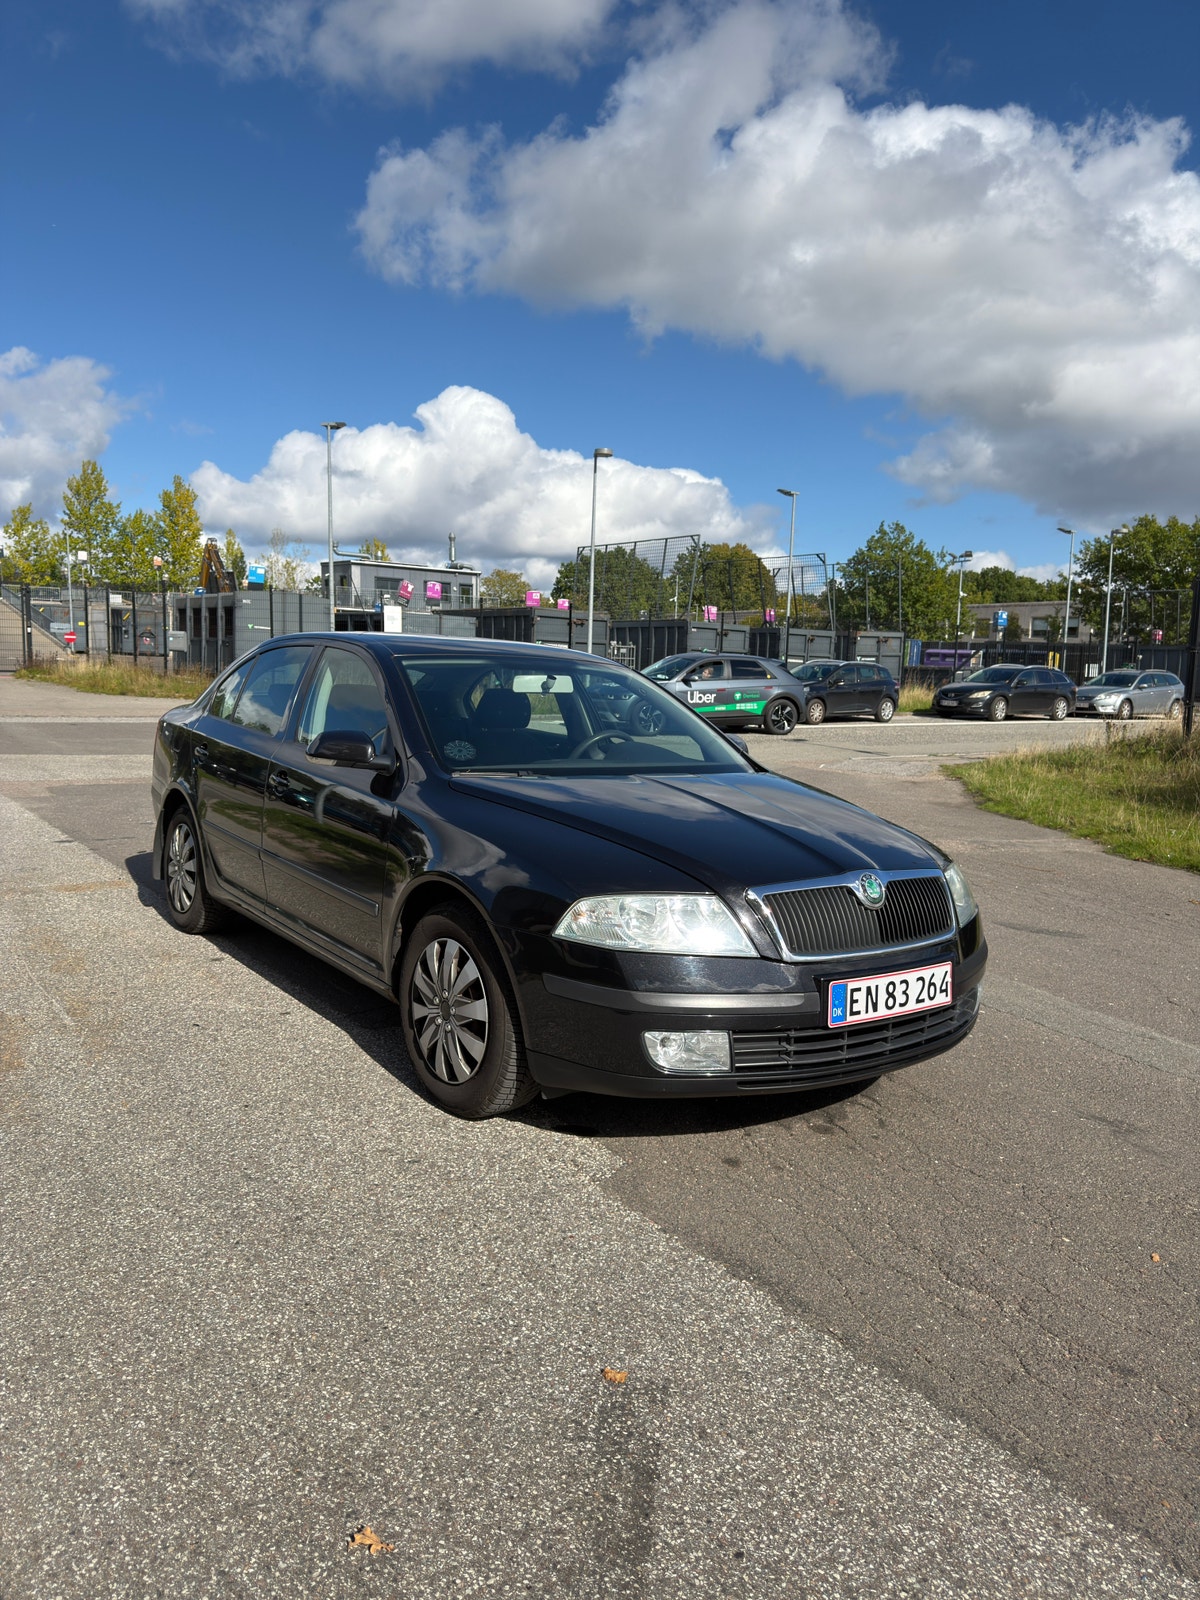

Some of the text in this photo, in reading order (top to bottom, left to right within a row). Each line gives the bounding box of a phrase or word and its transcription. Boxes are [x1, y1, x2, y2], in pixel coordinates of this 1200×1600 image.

[687, 690, 716, 703] Uber
[849, 970, 949, 1017] EN 83 264
[832, 1007, 843, 1017] DK
